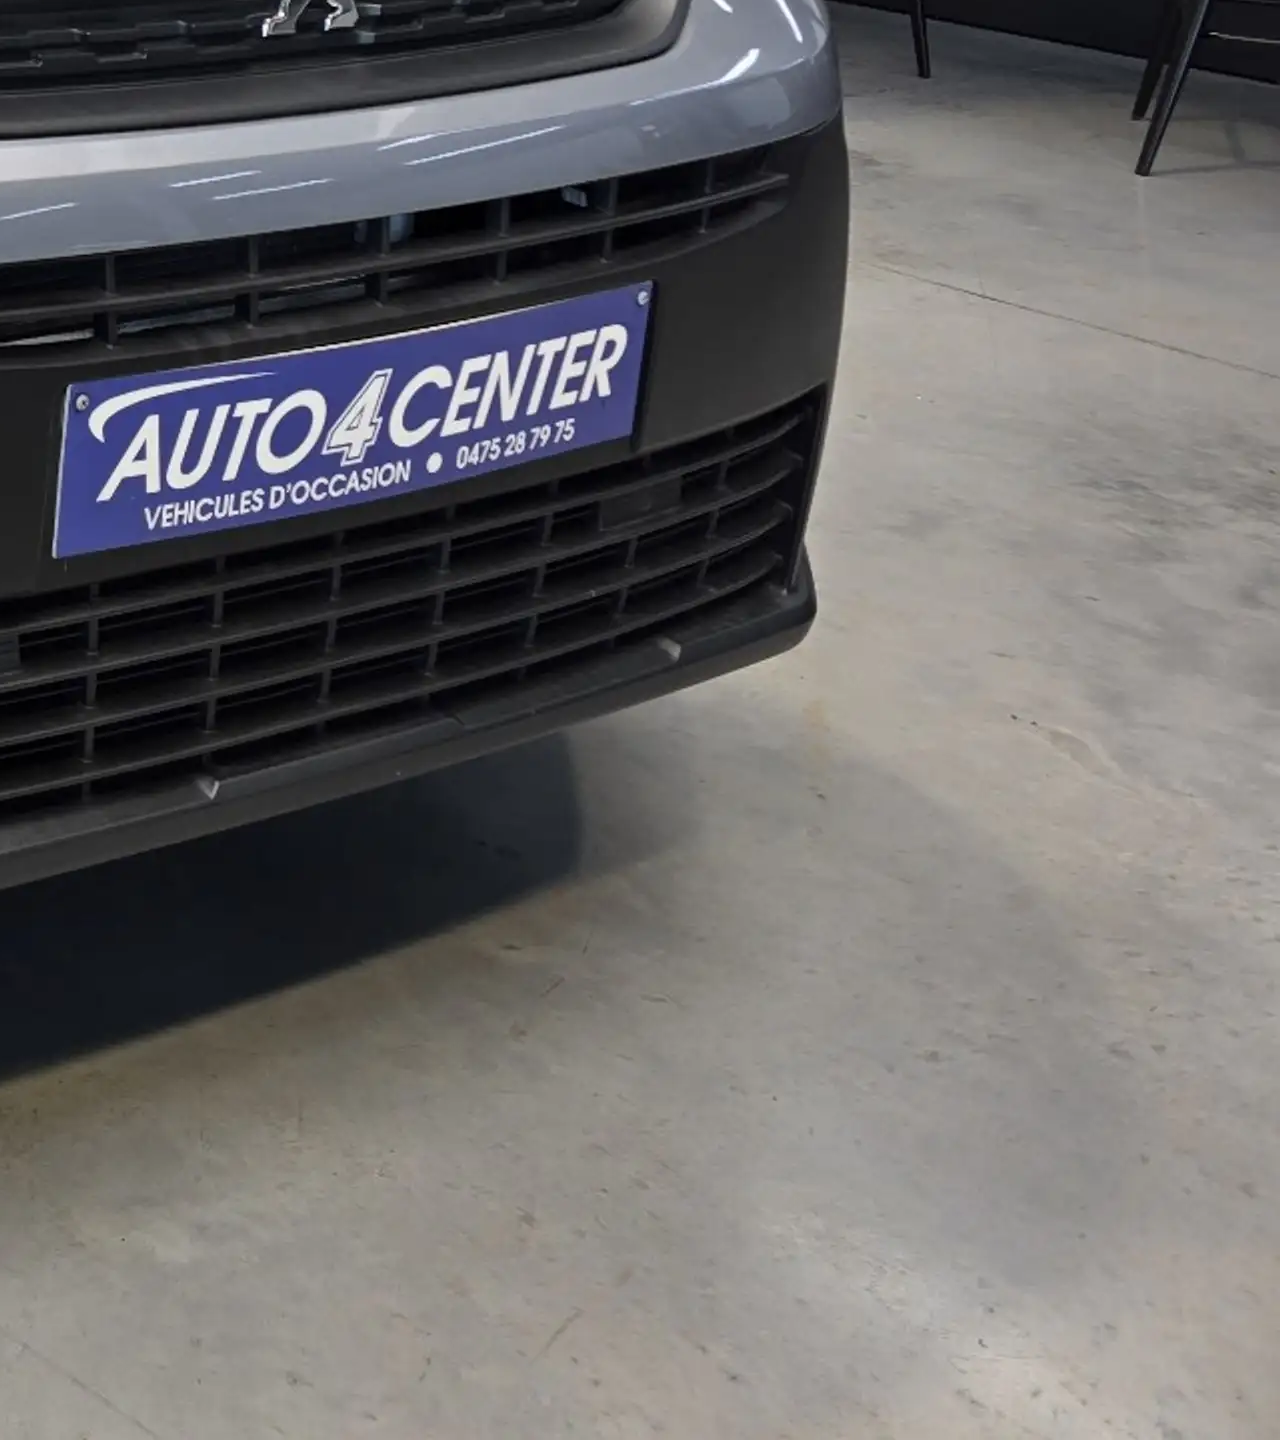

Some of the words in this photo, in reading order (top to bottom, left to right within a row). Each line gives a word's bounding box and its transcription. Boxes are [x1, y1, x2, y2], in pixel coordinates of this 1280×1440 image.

[144, 489, 264, 530] VEHICULES
[268, 459, 411, 510] D'OCCASION
[456, 437, 501, 469] 0475
[504, 431, 526, 457] 28
[529, 424, 551, 450] 79
[554, 418, 575, 442] 75
